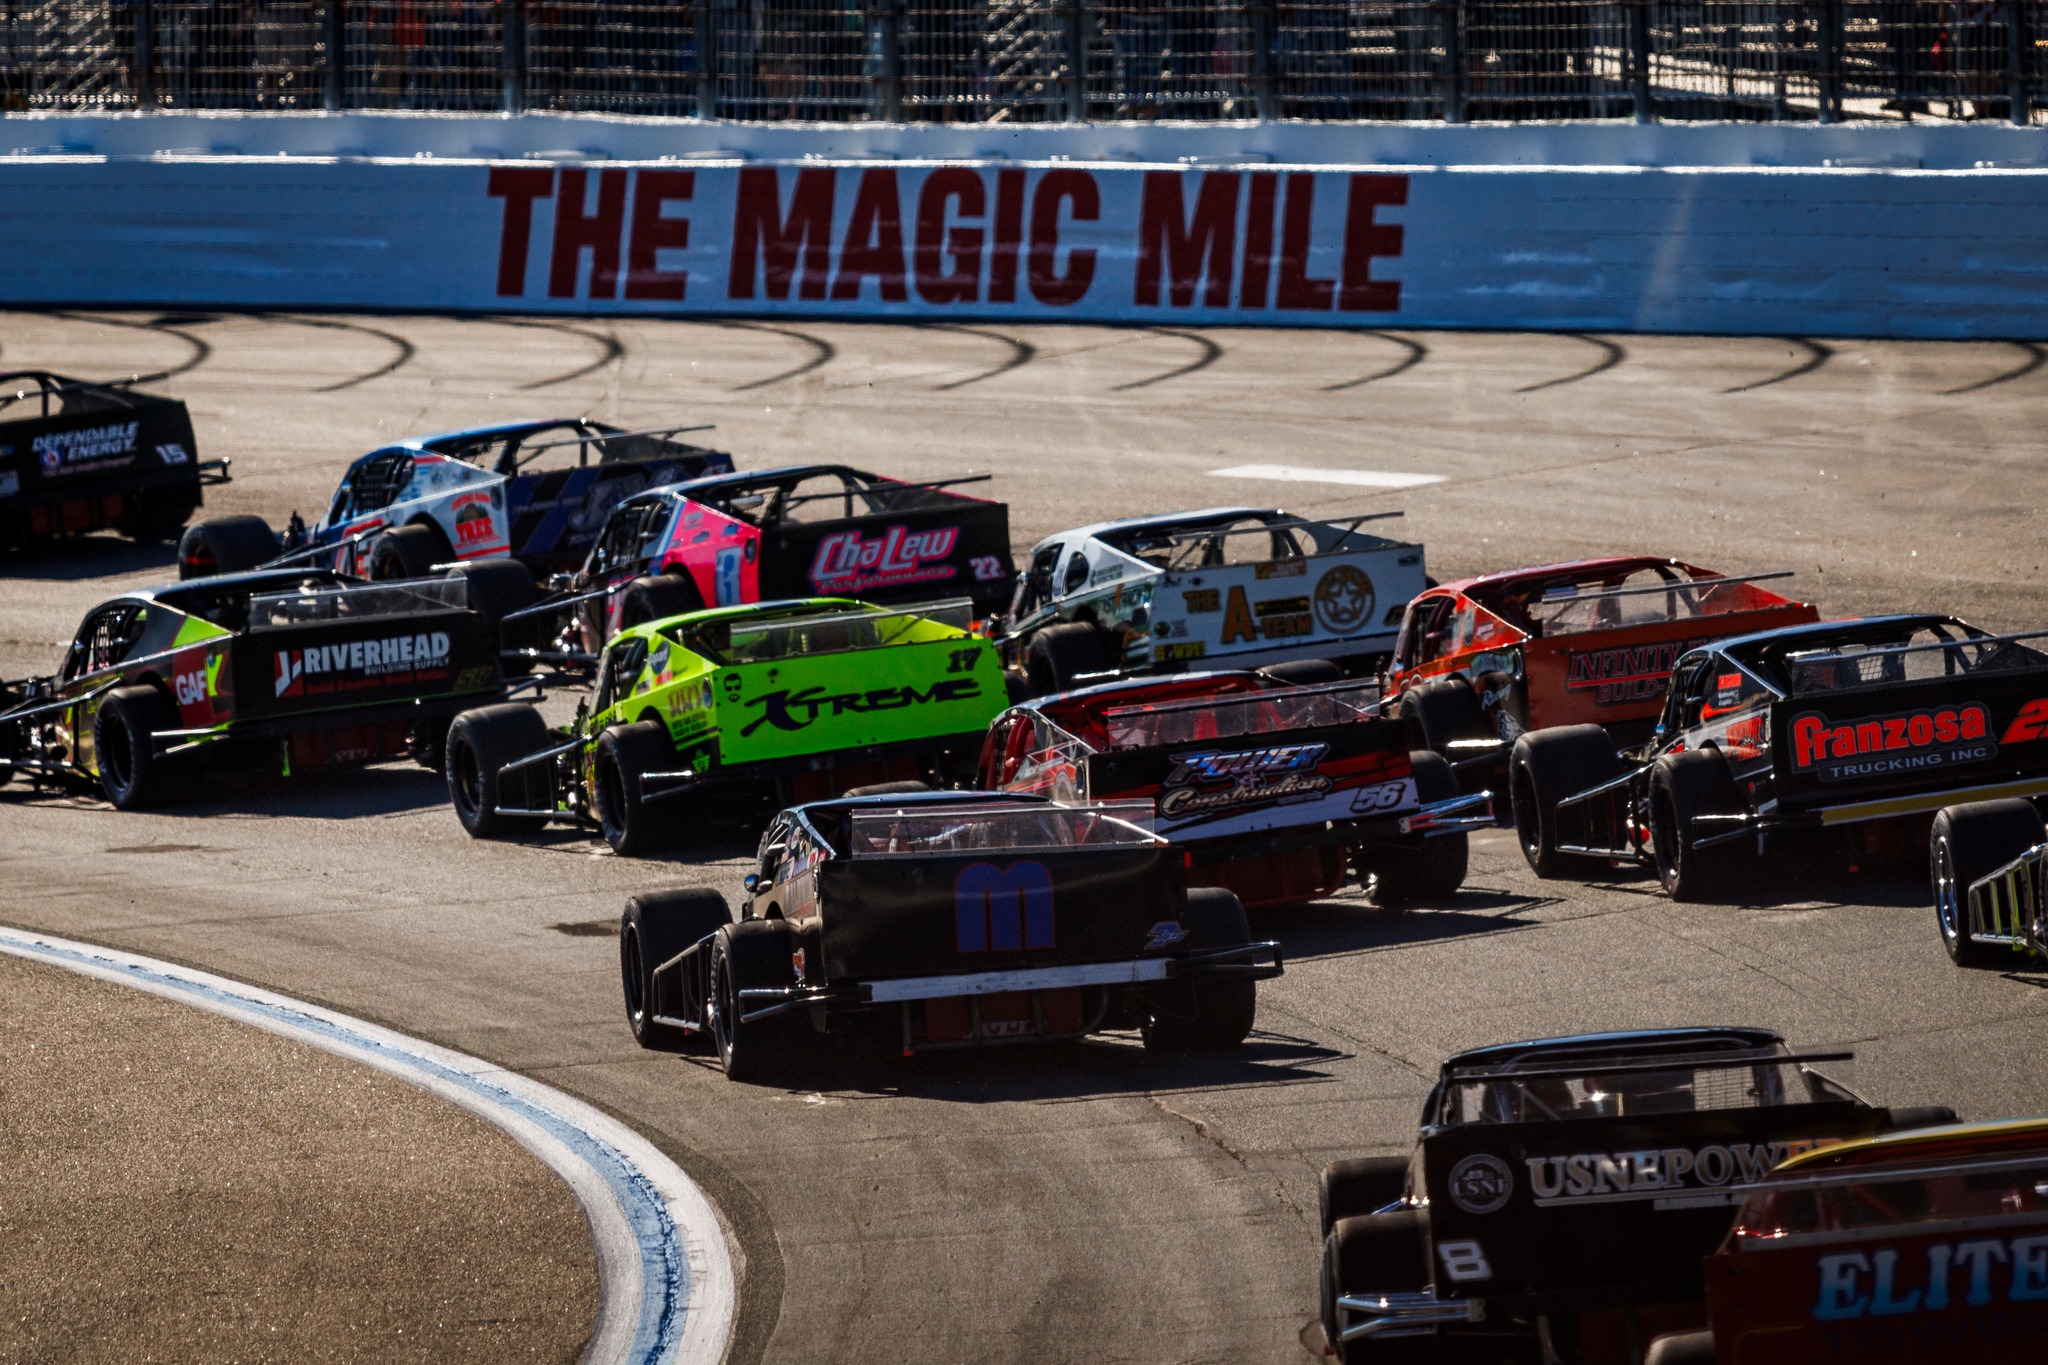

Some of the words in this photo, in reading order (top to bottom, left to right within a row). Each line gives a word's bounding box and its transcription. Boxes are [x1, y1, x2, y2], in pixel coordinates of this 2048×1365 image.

[489, 167, 695, 301] THE
[727, 167, 1100, 307] MAGIC
[1132, 169, 1410, 312] MILE
[32, 420, 140, 452] DEPENDABLE
[156, 443, 189, 465] 15
[455, 516, 494, 543] TREE
[811, 526, 956, 581] ChaLew
[968, 554, 1002, 581] 22
[1182, 587, 1219, 614] THE
[302, 630, 450, 675] RIVERHEAD
[364, 661, 411, 677] BUILDING
[413, 655, 450, 670] SUPPLY
[946, 646, 983, 673] 17
[1569, 641, 1683, 681] INFINITY
[175, 669, 206, 706] GAF
[739, 677, 983, 738] XTREME
[1166, 743, 1328, 784] POWER
[1829, 751, 1943, 780] TRUCKING
[1950, 747, 1988, 762] INC
[1161, 774, 1329, 815] Construction
[1349, 781, 1407, 814] 56
[1524, 1137, 1846, 1199] USNEPOW
[1436, 1238, 1494, 1284] 8
[1811, 1234, 2048, 1322] ELITE
